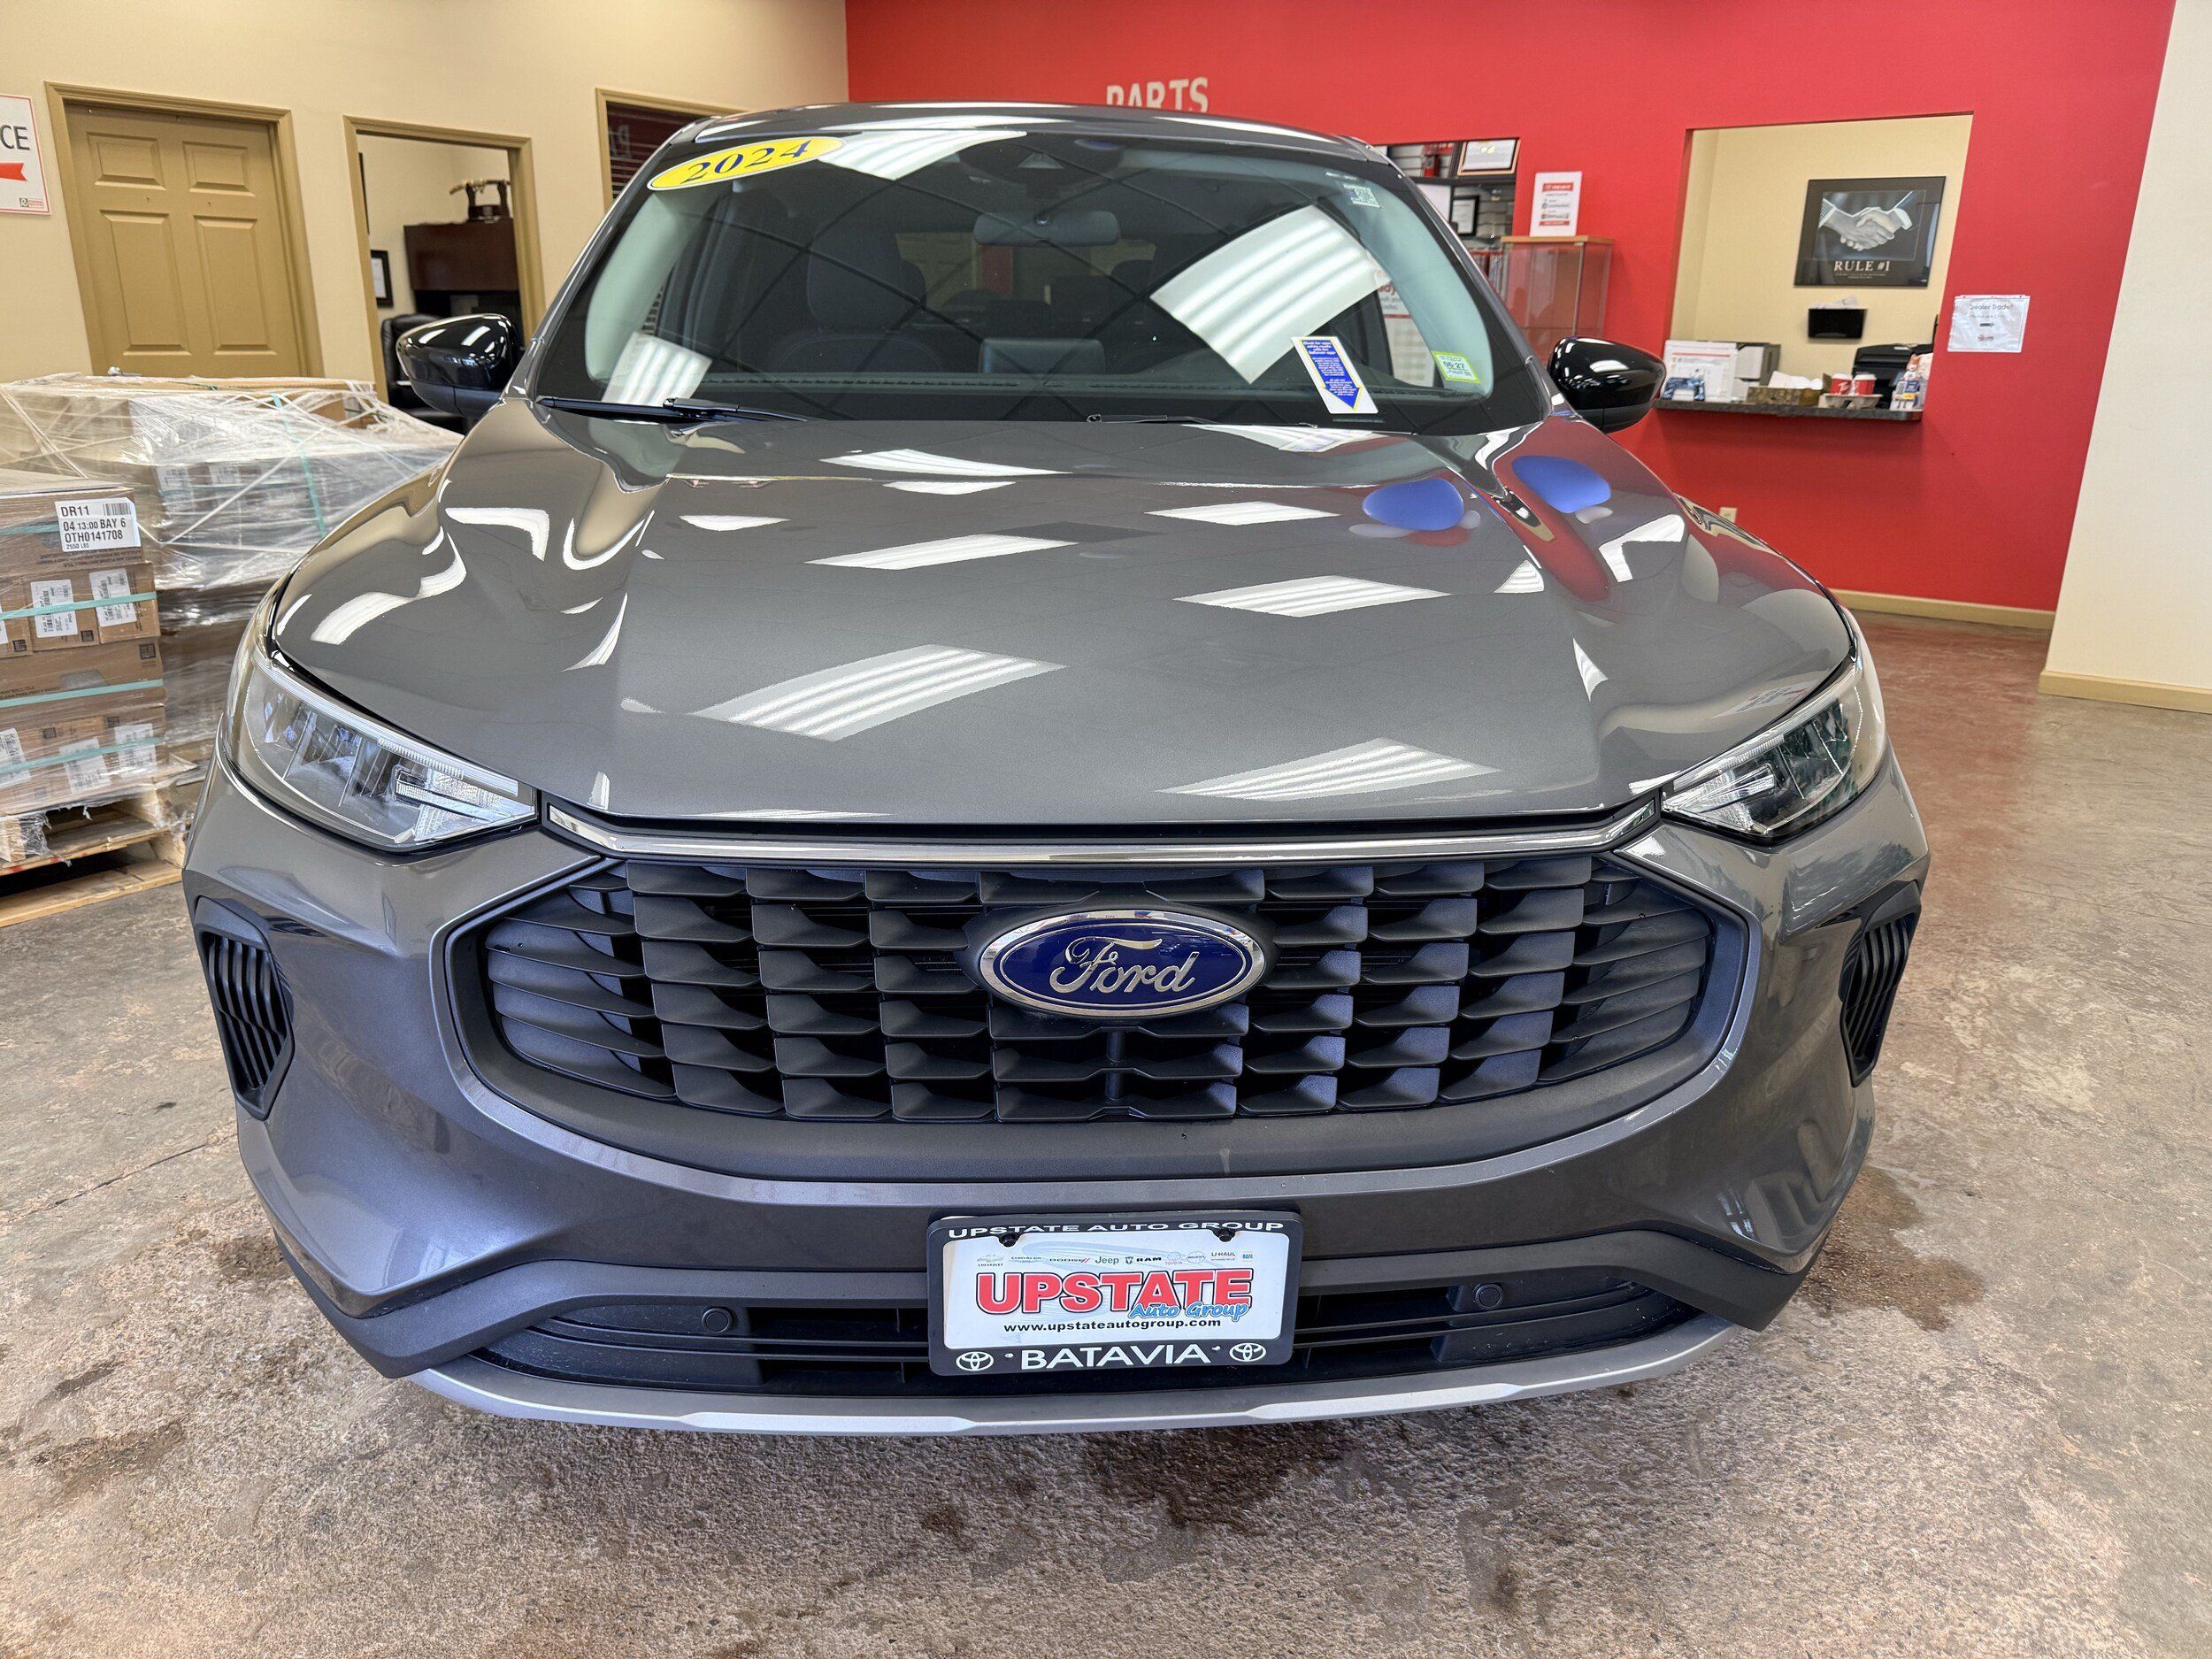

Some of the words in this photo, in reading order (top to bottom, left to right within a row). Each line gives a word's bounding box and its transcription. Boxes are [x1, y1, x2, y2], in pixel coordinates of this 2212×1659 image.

[1106, 76, 1209, 113] PARTS
[0, 124, 31, 150] CE
[680, 139, 812, 185] 2024
[1833, 260, 1874, 272] RULE
[60, 505, 89, 518] DR11
[63, 521, 75, 532] 04
[77, 521, 98, 530] 13:00
[99, 518, 117, 529] BAY
[120, 518, 127, 528] 6
[1049, 936, 1200, 994] Ford
[949, 1225, 1079, 1239] UPSTATE
[1178, 1222, 1284, 1232] GROUP
[1094, 1256, 1120, 1265] Jeep
[976, 1268, 1254, 1315] UPSTATE
[1128, 1302, 1180, 1318] Auto
[1186, 1301, 1250, 1322] Group
[1003, 1319, 1221, 1333] www.upstateautogroup.com
[1021, 1344, 1212, 1371] BATAVIA
